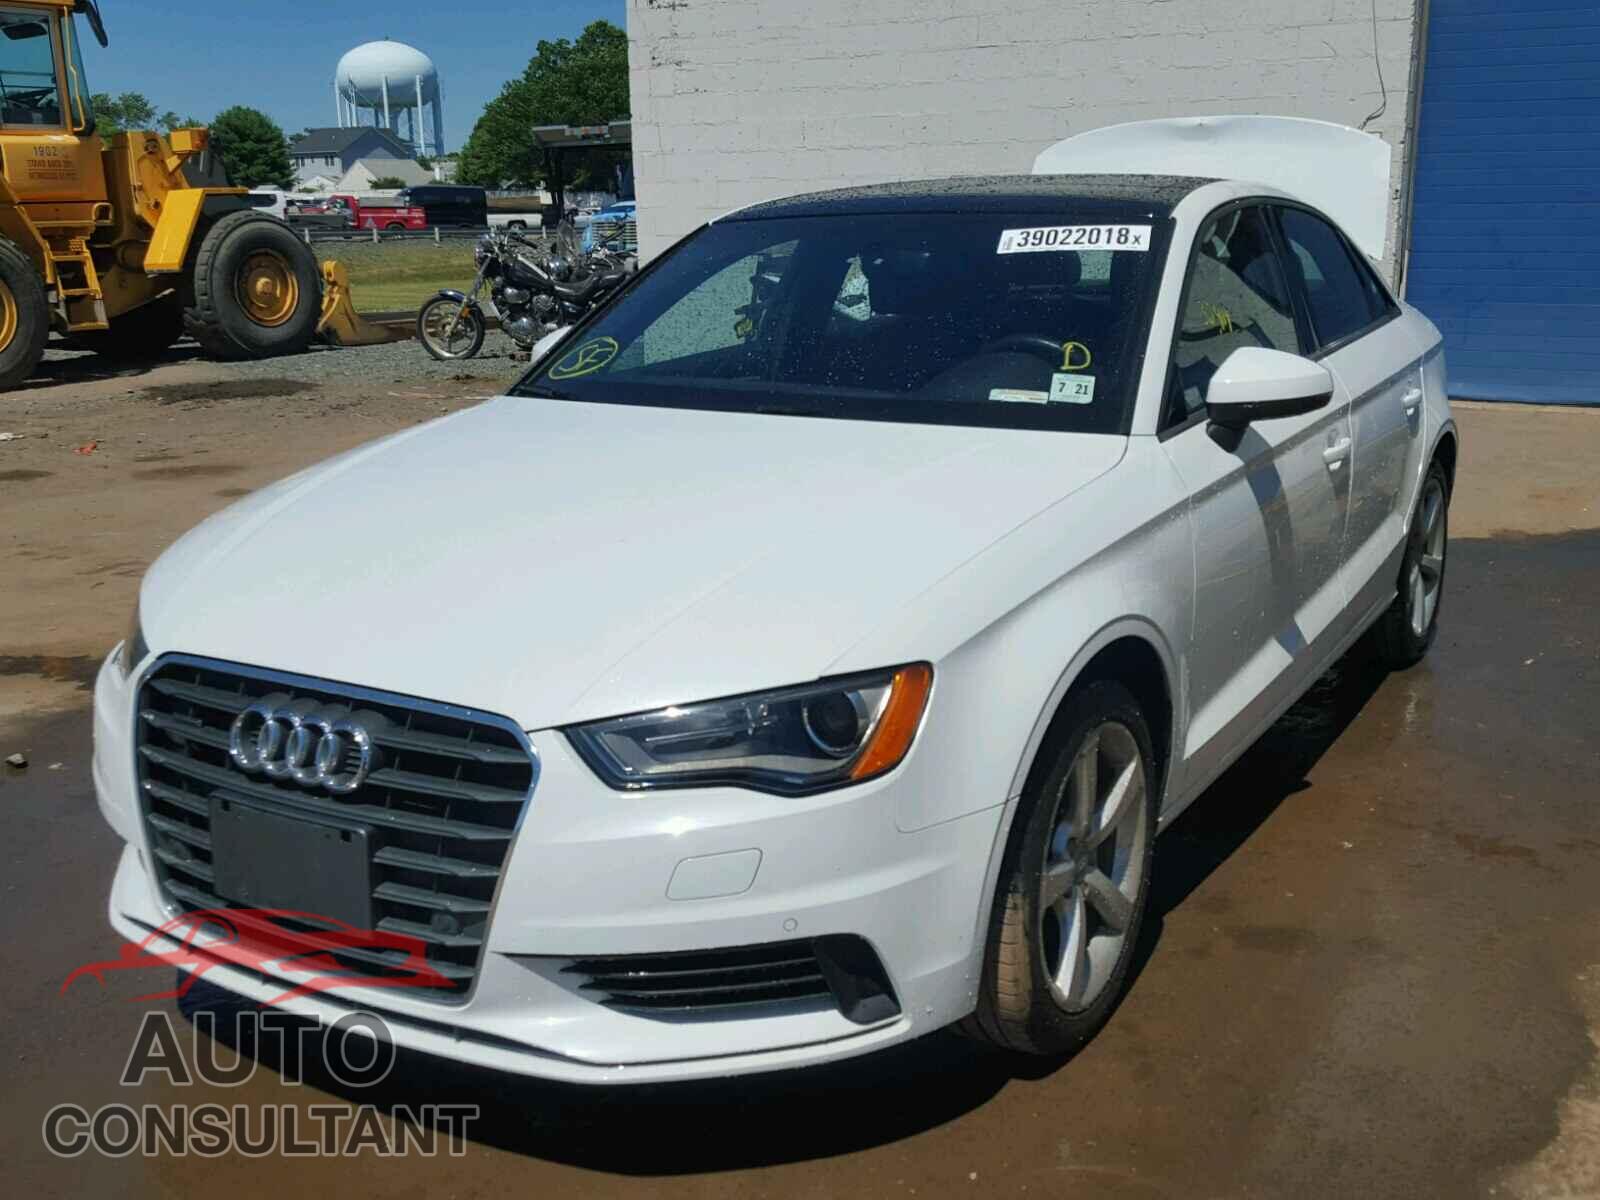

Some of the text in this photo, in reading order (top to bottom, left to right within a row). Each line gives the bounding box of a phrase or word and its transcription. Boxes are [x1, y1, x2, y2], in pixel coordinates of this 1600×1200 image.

[1060, 341, 1092, 370] D
[1059, 382, 1089, 395] 7 21
